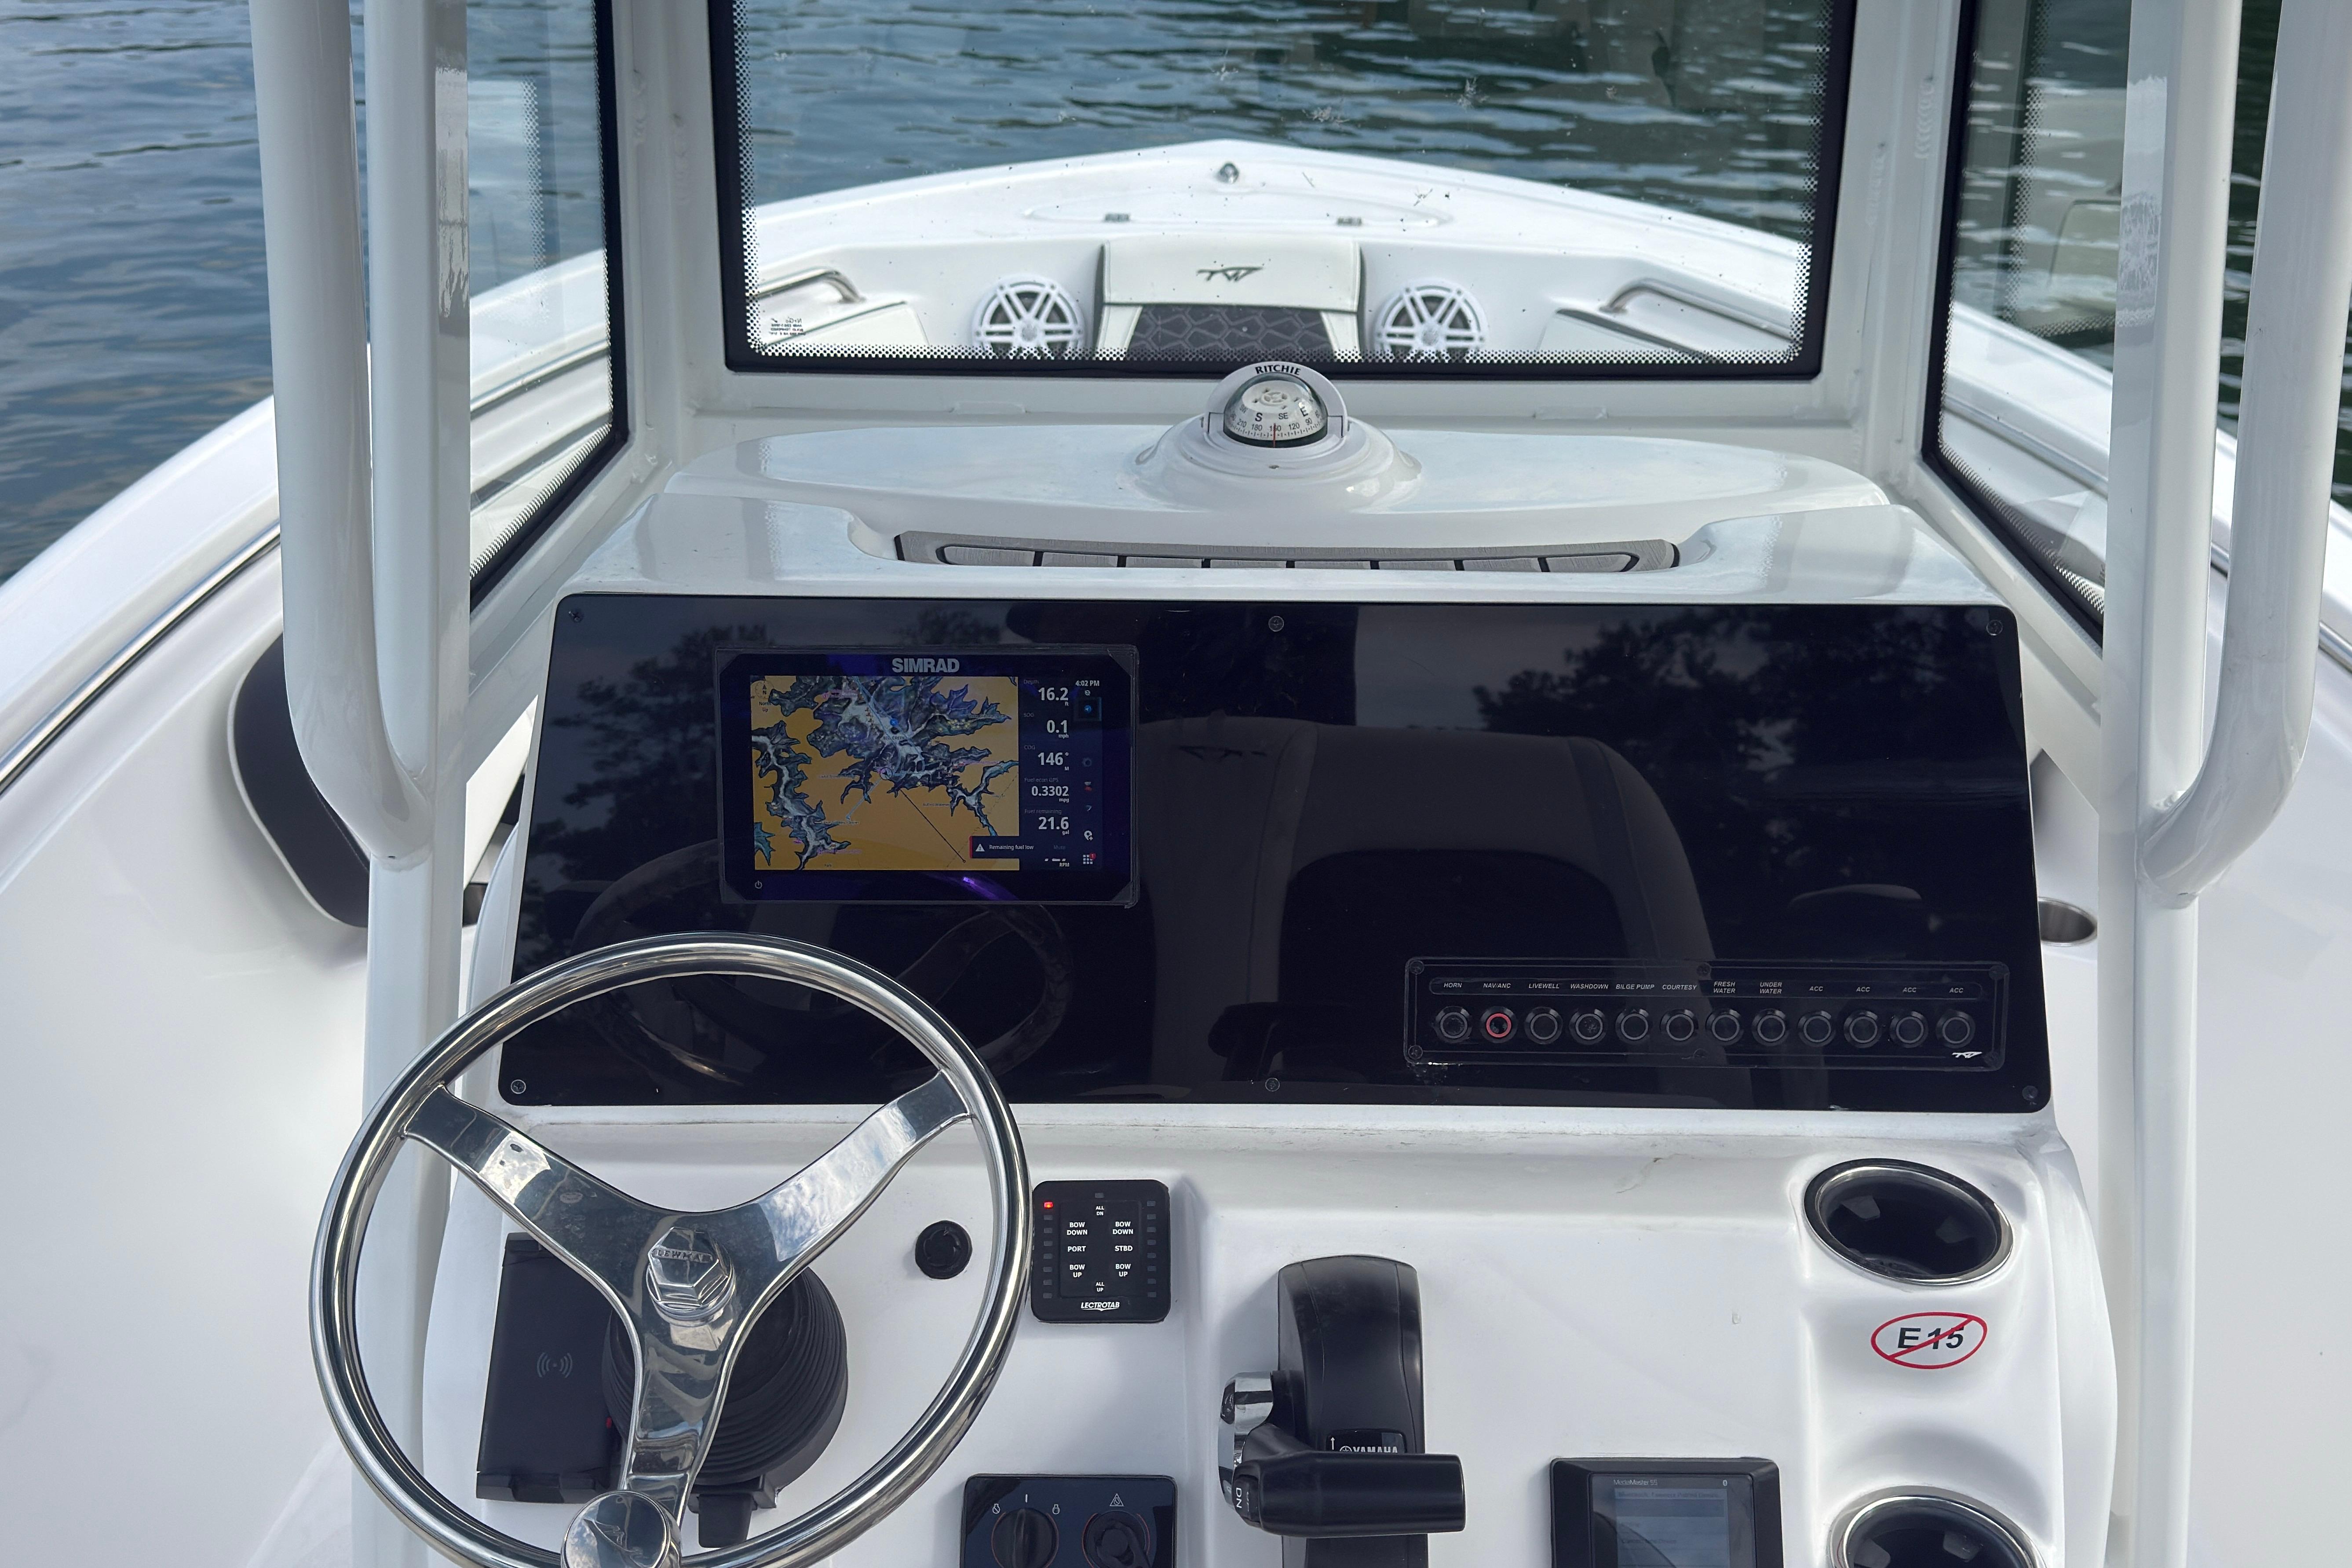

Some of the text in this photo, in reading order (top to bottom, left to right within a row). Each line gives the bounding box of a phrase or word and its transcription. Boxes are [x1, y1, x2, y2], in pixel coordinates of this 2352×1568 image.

[1255, 364, 1301, 376] RITCHIE
[1255, 412, 1263, 422] S
[1300, 406, 1308, 417] E
[1237, 419, 1247, 428] 210
[892, 658, 960, 673] SIMRAD
[1038, 687, 1069, 701] 16.2
[1047, 720, 1067, 733] 0.1
[1031, 786, 1069, 797] 0.3302
[1038, 816, 1069, 830] 21.6
[657, 1249, 710, 1263] LEWMA
[1236, 1487, 1242, 1509] DN
